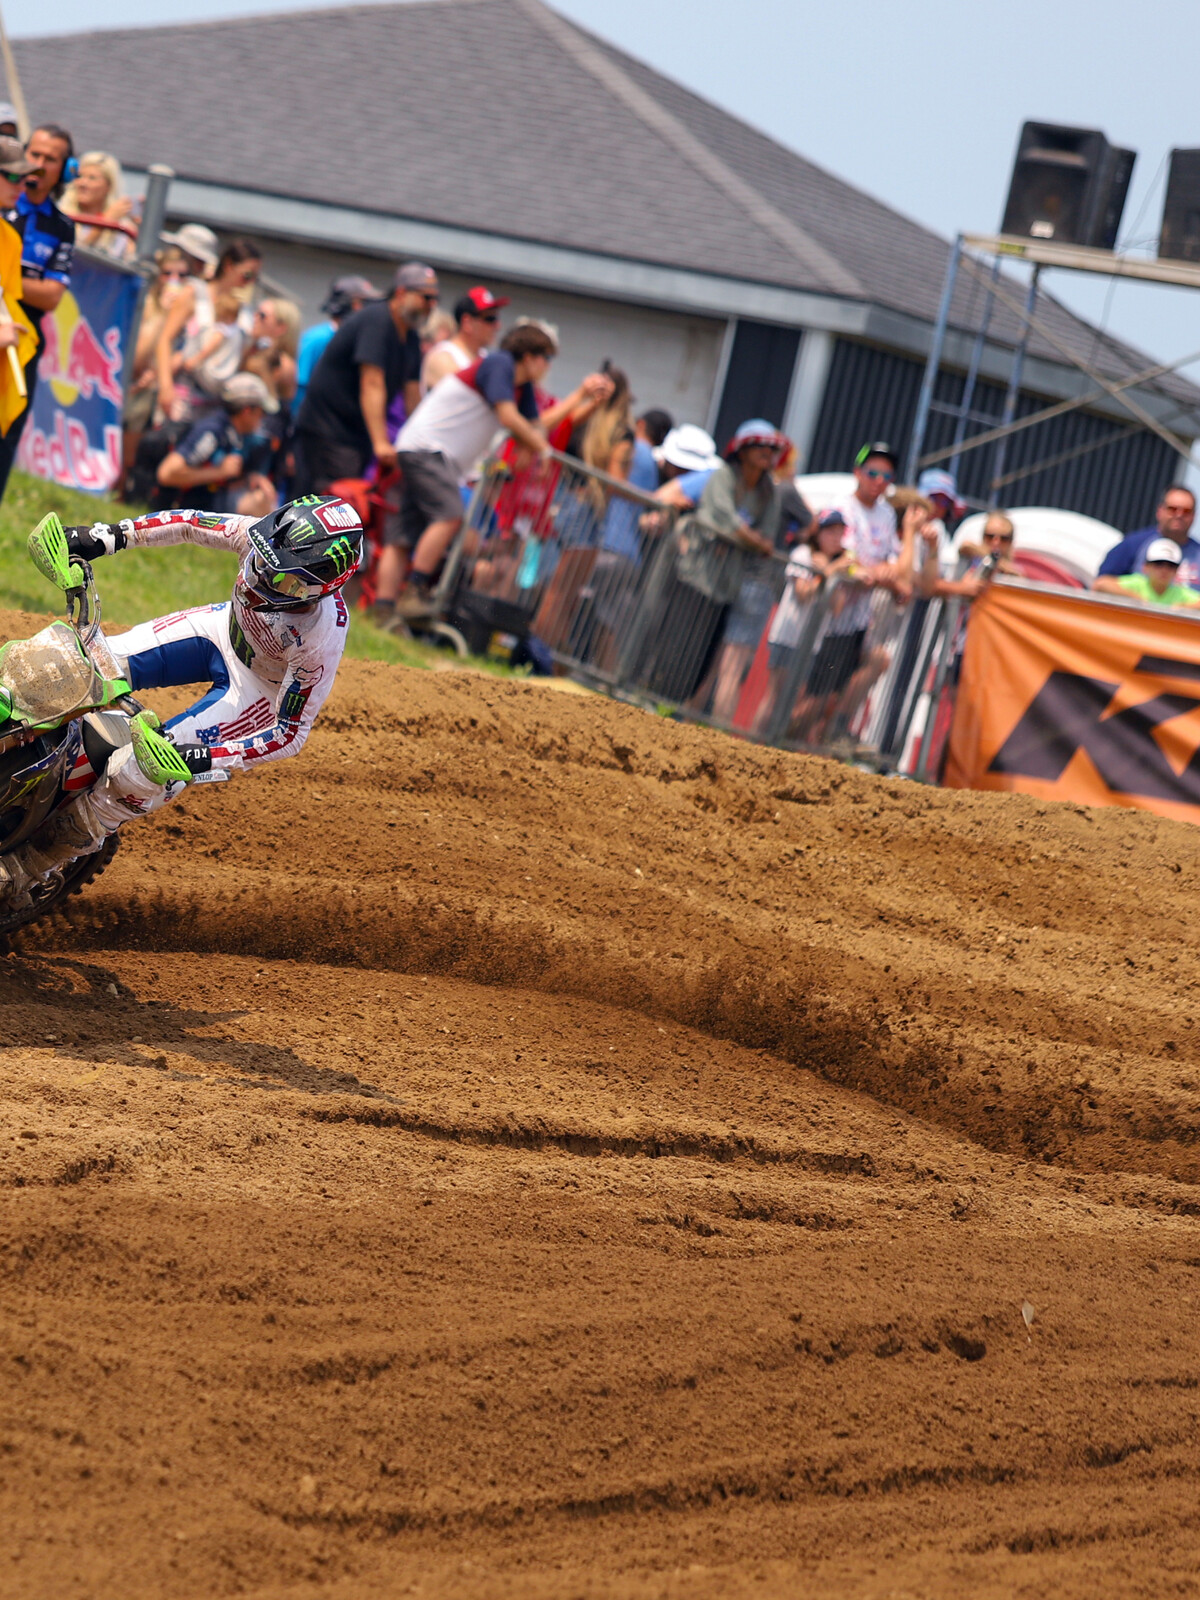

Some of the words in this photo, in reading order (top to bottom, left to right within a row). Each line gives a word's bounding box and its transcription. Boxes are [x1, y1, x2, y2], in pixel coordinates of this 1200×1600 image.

[251, 529, 281, 567] MONSTER
[64, 642, 84, 664] LUCAS
[185, 747, 208, 762] FOX
